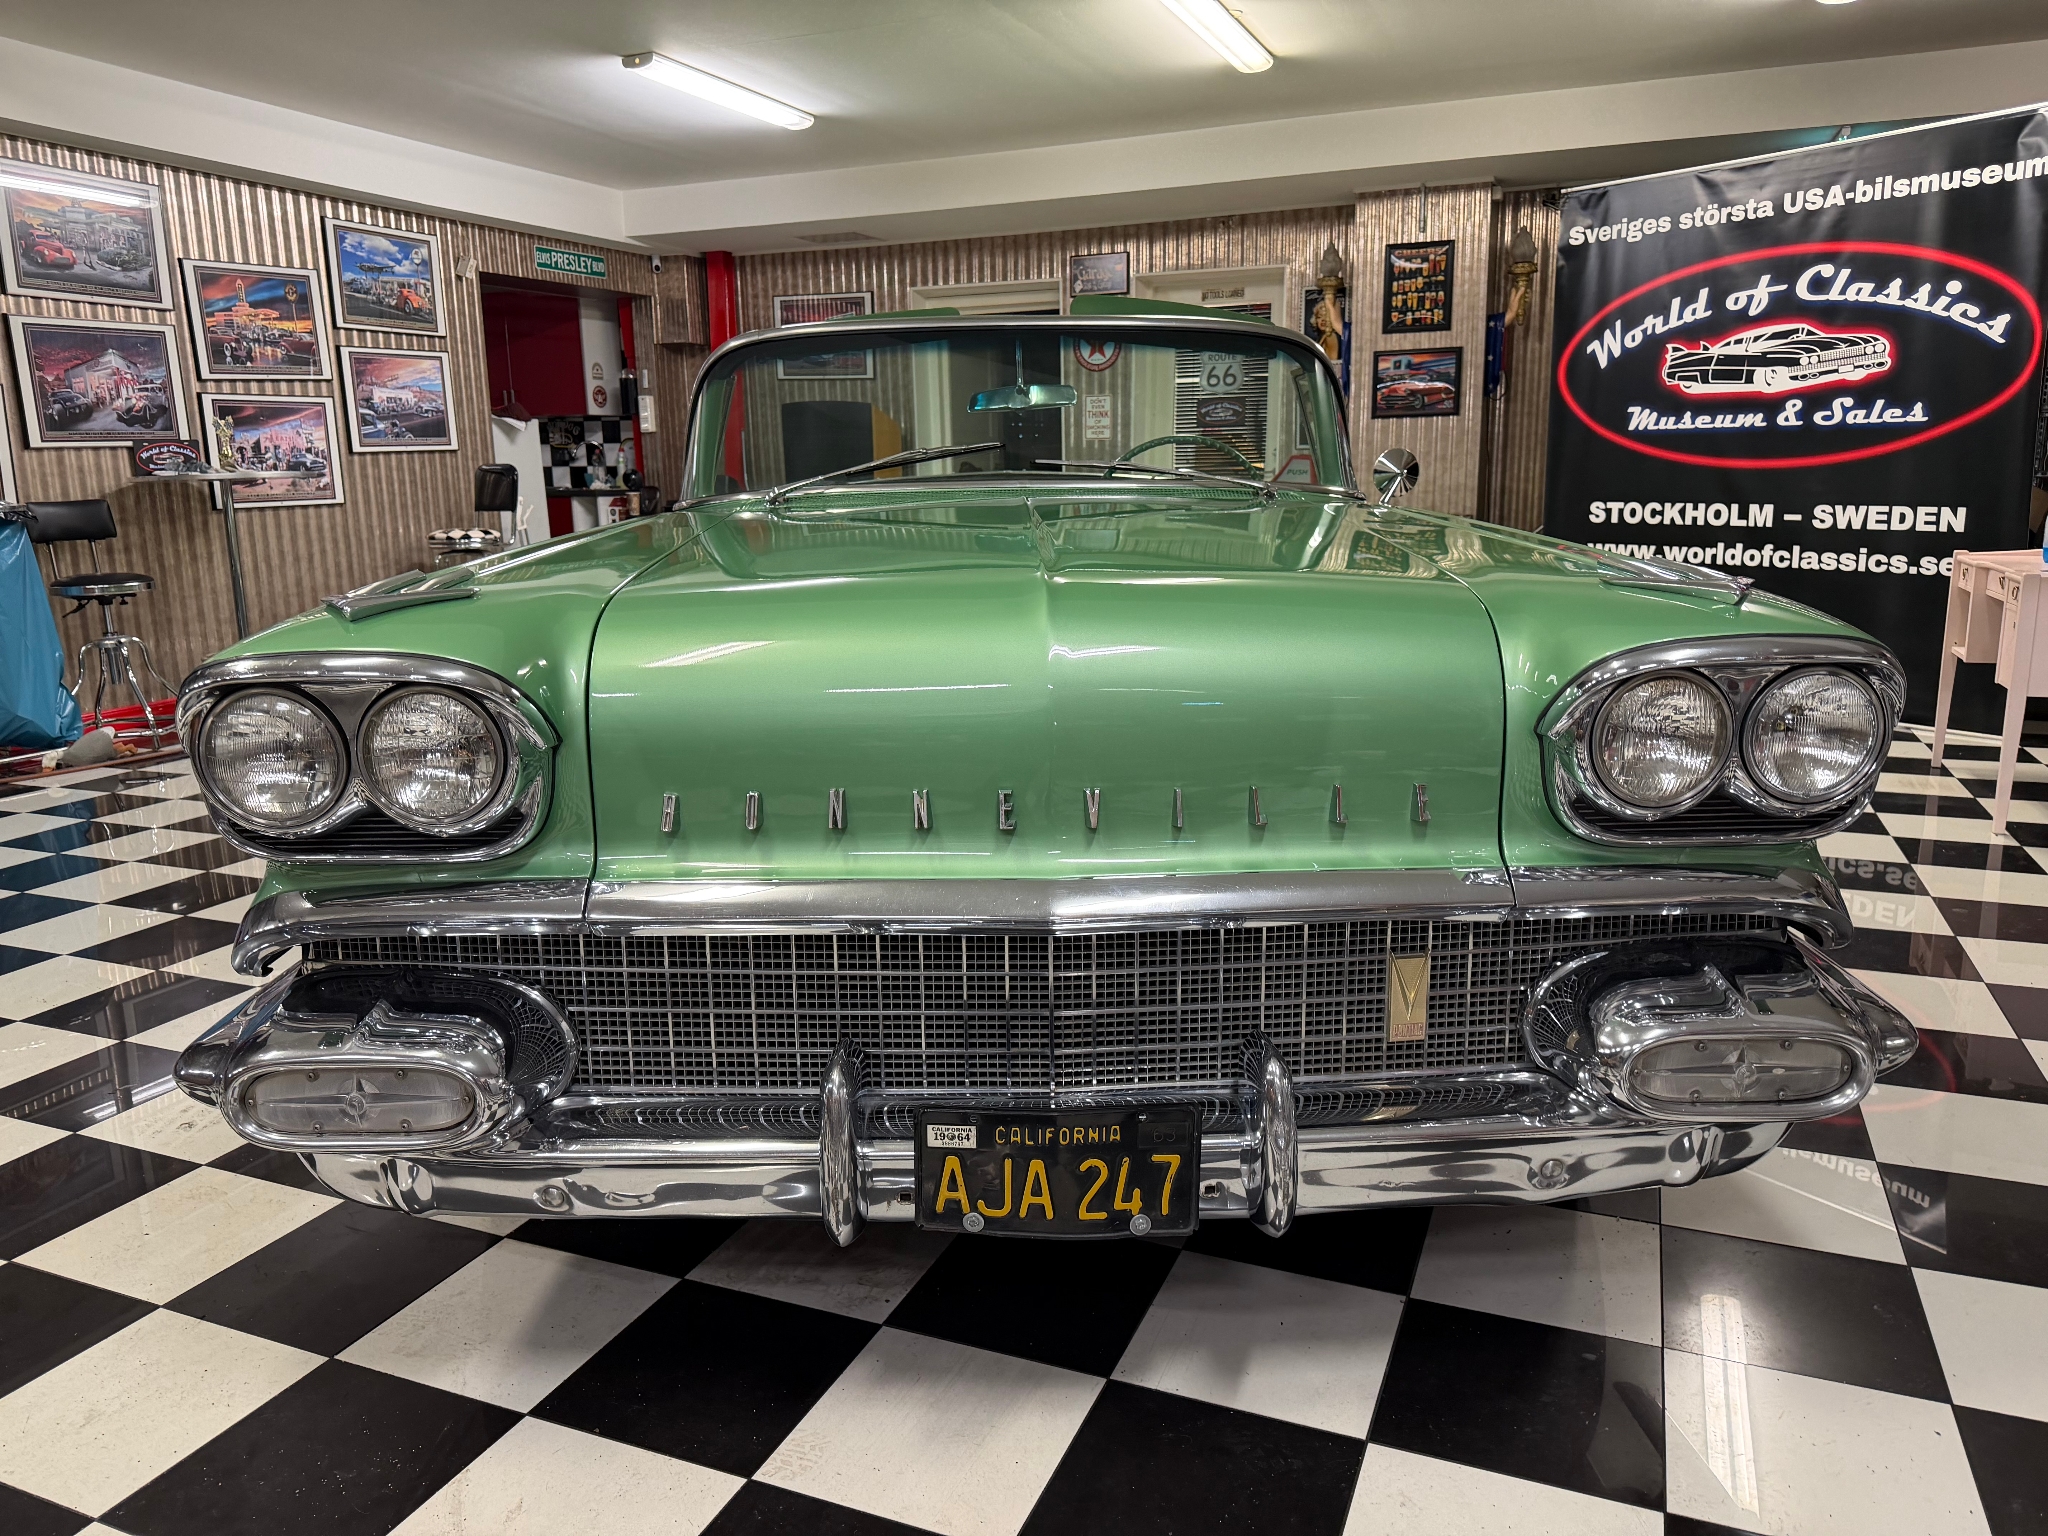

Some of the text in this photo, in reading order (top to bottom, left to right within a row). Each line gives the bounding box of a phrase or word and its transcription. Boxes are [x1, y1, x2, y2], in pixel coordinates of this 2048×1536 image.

[1568, 154, 2048, 246] Sveriges största USA-bilsmuseum
[536, 251, 605, 273] ELVIS PRESLEY BLVD
[1587, 263, 2012, 370] World of Classics
[1208, 353, 1237, 362] ROUTE
[1207, 364, 1237, 387] 66
[1087, 411, 1110, 419] THINK
[1626, 397, 1928, 431] Museum & Sales
[140, 447, 159, 459] World
[169, 445, 196, 458] Classics
[1588, 501, 1774, 528] STOCKHOLM
[1812, 504, 1966, 533] SWEDEN
[1393, 1024, 1423, 1038] PONTIAC
[995, 1125, 1121, 1146] CALIFORNIA
[935, 1154, 1181, 1221] AJA 247
